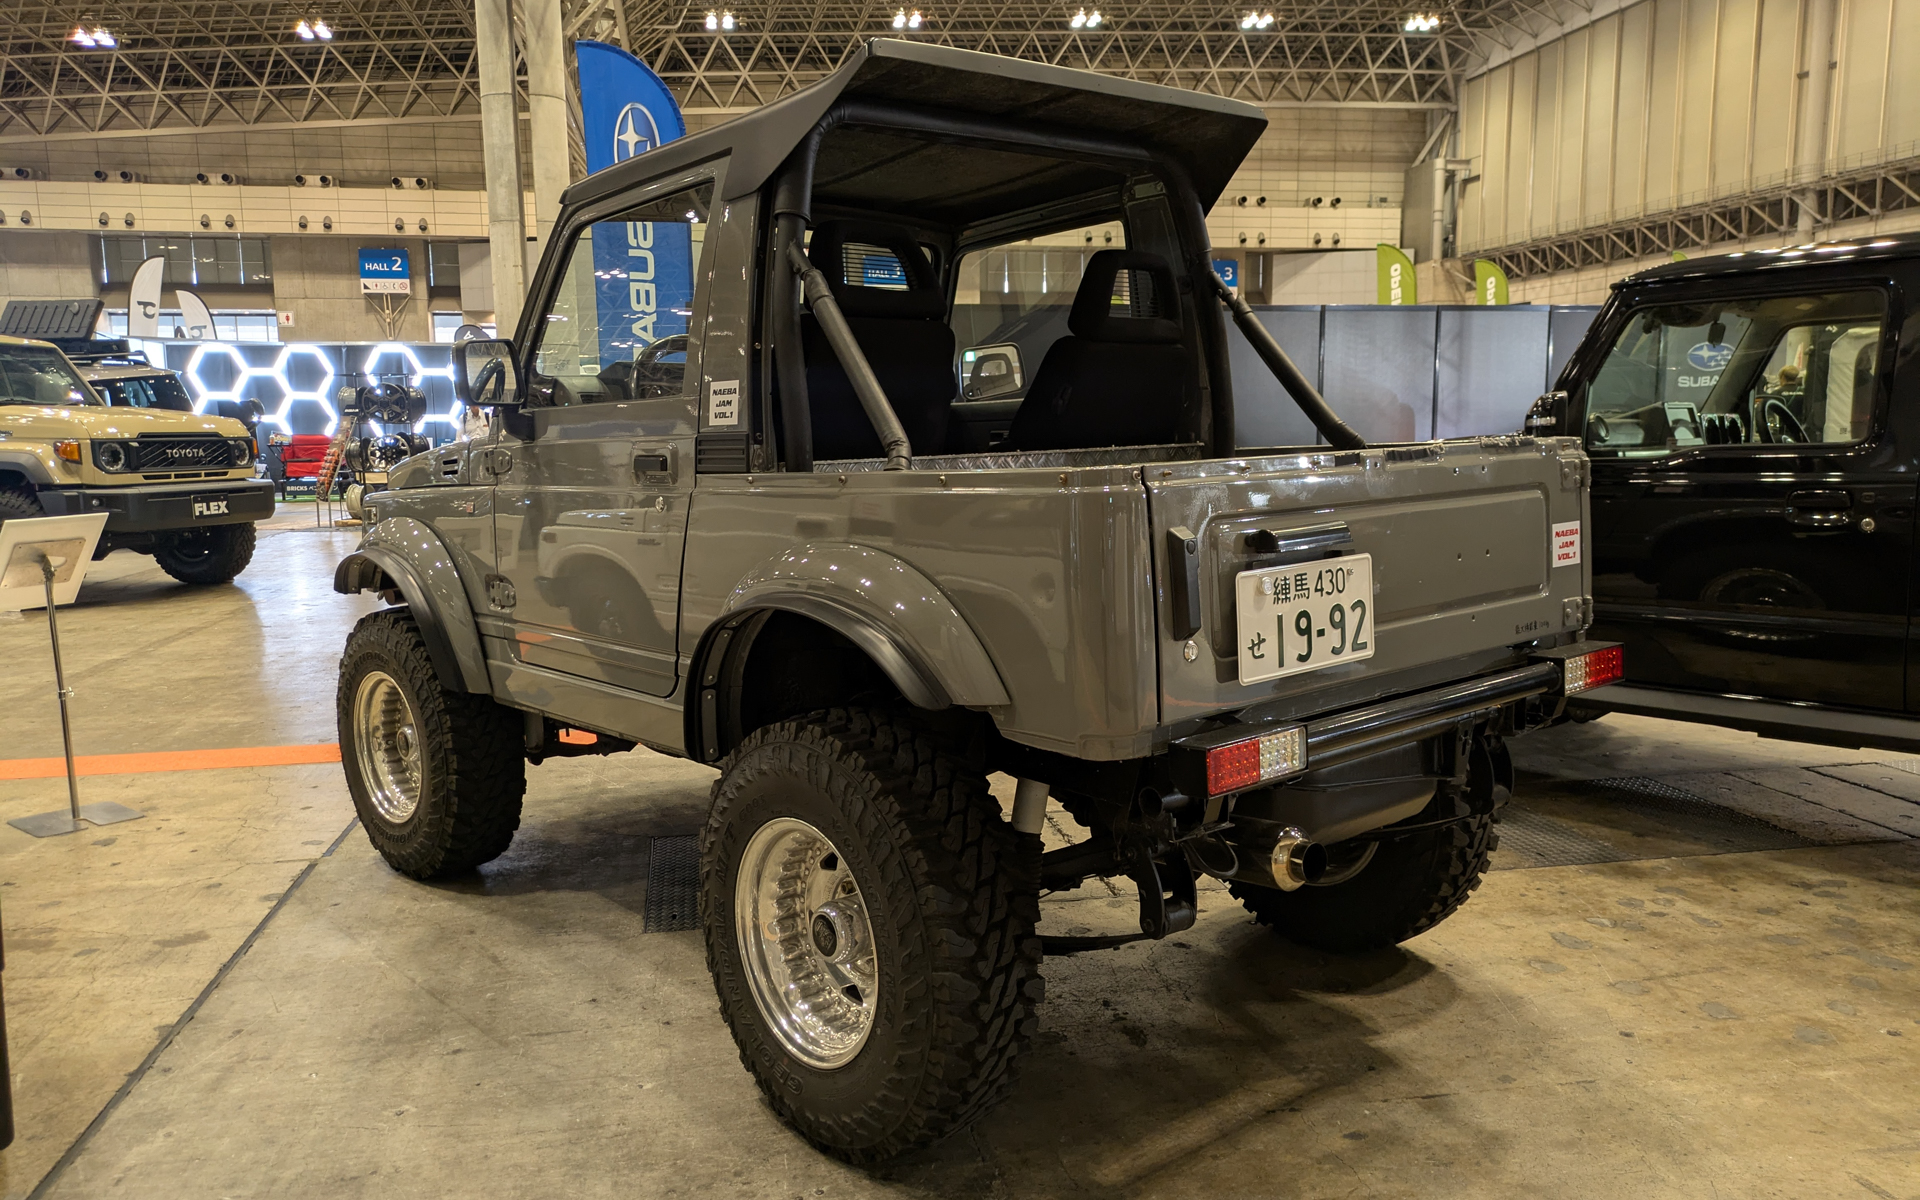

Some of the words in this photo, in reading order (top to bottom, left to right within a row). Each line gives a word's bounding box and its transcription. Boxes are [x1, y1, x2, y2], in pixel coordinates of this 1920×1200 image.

[365, 262, 389, 271] HALL
[391, 256, 402, 271] 2
[1223, 267, 1233, 281] 3
[712, 387, 737, 397] NAEBA
[715, 399, 733, 408] JAM
[714, 411, 734, 419] VOL.1
[166, 448, 206, 458] TOYOTA
[194, 500, 229, 516] FLEX
[1554, 527, 1579, 538] NAEBA
[1558, 539, 1575, 550] JAM
[1557, 551, 1577, 561] VOL.1
[1272, 572, 1311, 605] 練馬
[1314, 566, 1346, 597] 430
[1247, 631, 1267, 660] せ
[1276, 598, 1368, 669] 19-92
[713, 893, 804, 1096] GEOLANDAR
